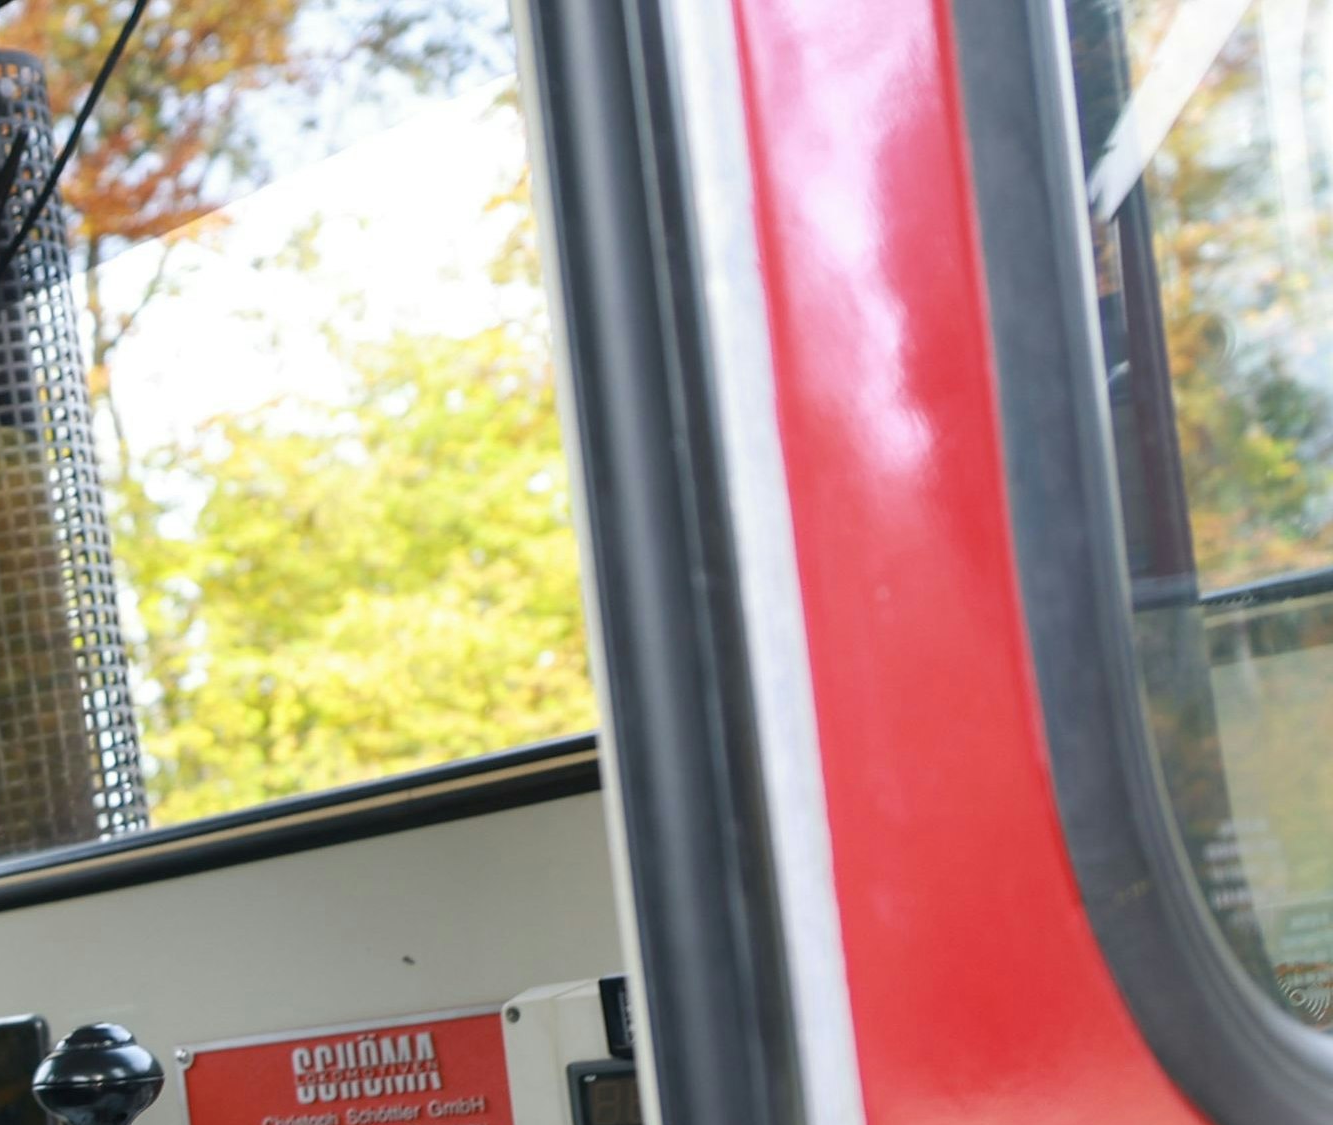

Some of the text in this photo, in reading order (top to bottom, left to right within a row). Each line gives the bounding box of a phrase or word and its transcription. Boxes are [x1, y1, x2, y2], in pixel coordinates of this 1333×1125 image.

[292, 1031, 442, 1105] SCHÖMA
[346, 1104, 421, 1125] Schöttler
[428, 1096, 485, 1118] GmbH
